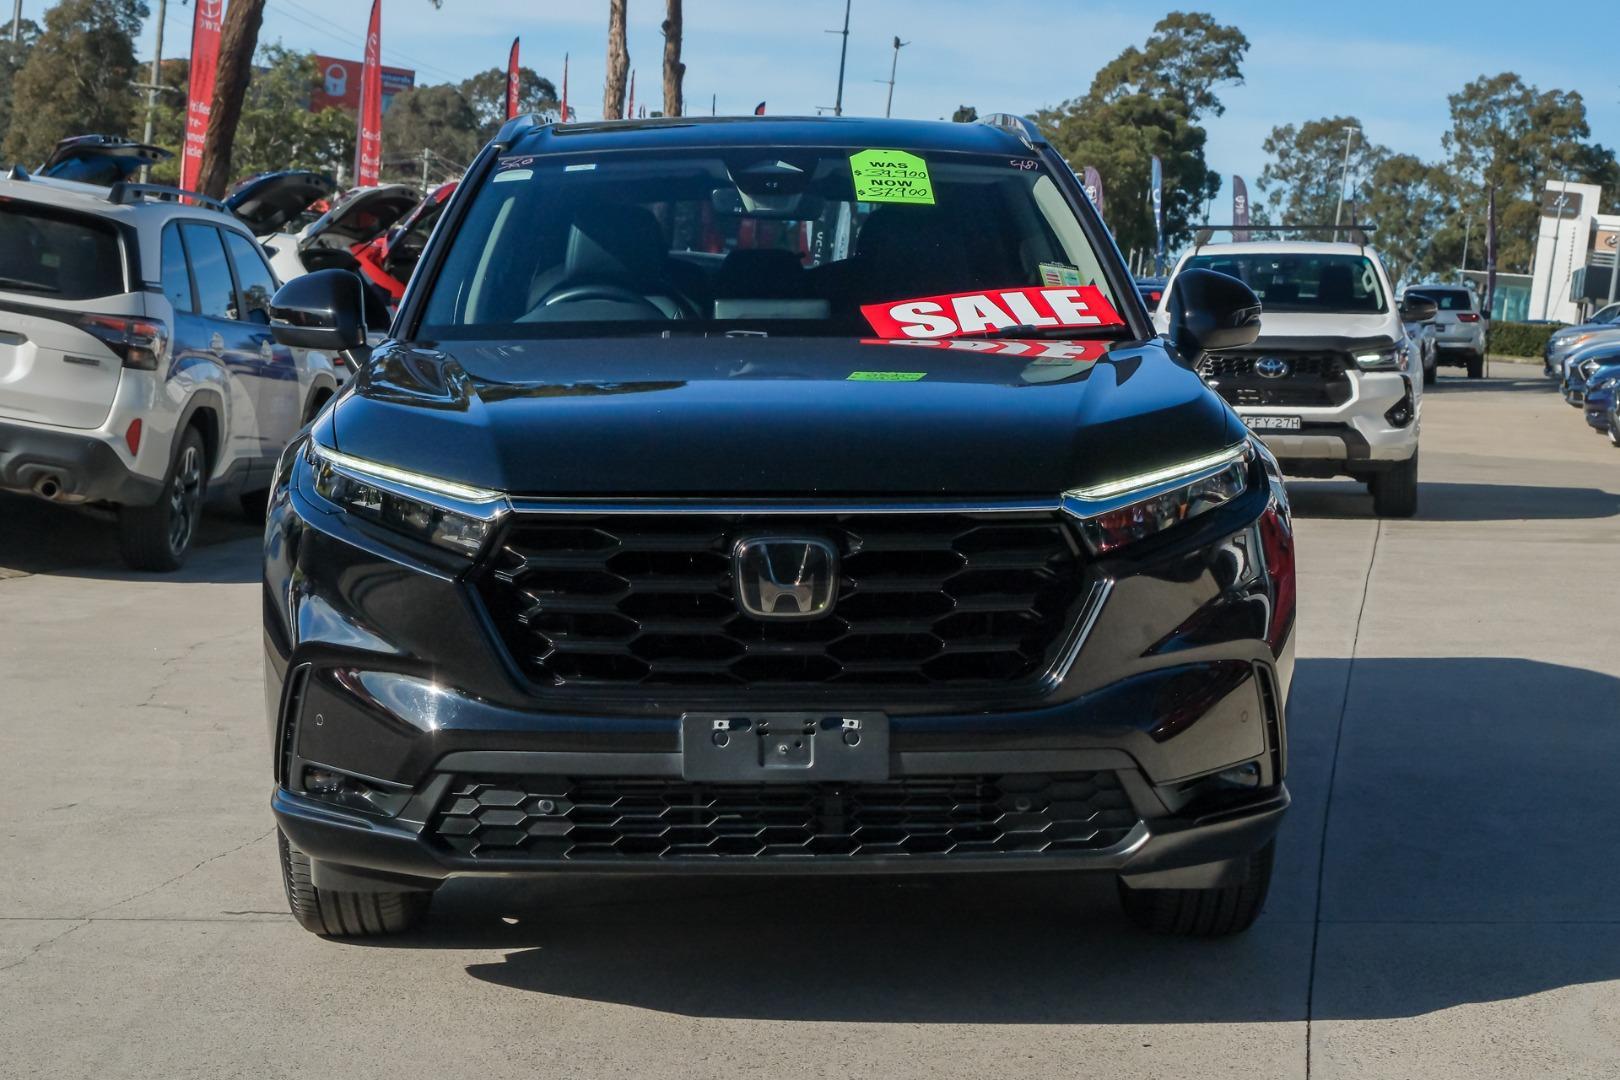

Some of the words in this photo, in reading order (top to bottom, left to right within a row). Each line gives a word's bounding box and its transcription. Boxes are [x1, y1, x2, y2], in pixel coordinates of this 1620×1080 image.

[869, 161, 909, 169] WAS
[871, 179, 913, 187] NOW
[889, 289, 1101, 338] SALE
